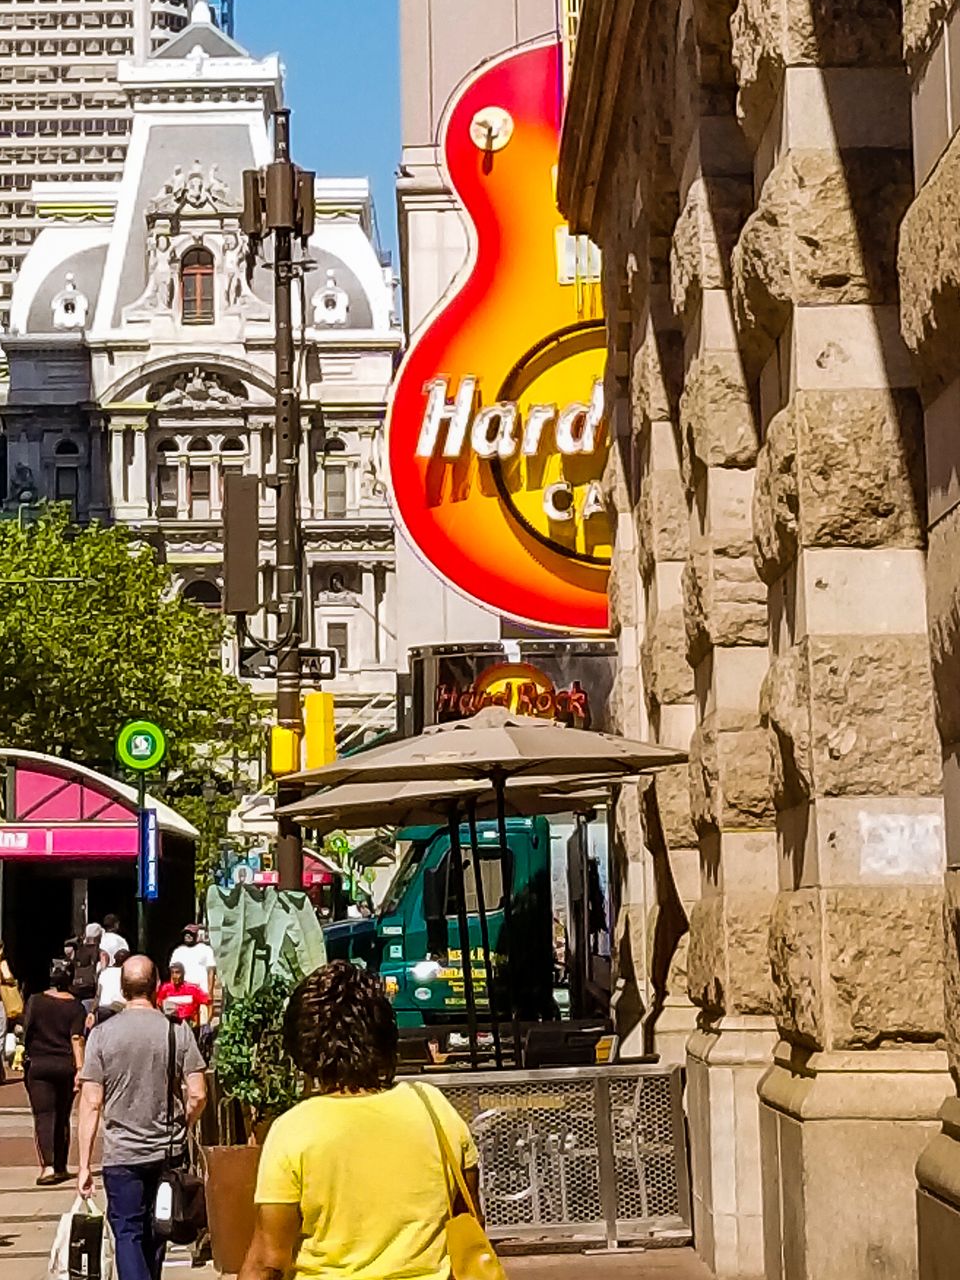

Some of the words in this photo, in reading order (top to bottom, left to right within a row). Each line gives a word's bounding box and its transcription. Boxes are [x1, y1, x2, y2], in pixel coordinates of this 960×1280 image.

[414, 374, 604, 458] Hard
[543, 481, 606, 520] CA
[436, 682, 512, 717] Hard
[516, 680, 587, 719] Rock
